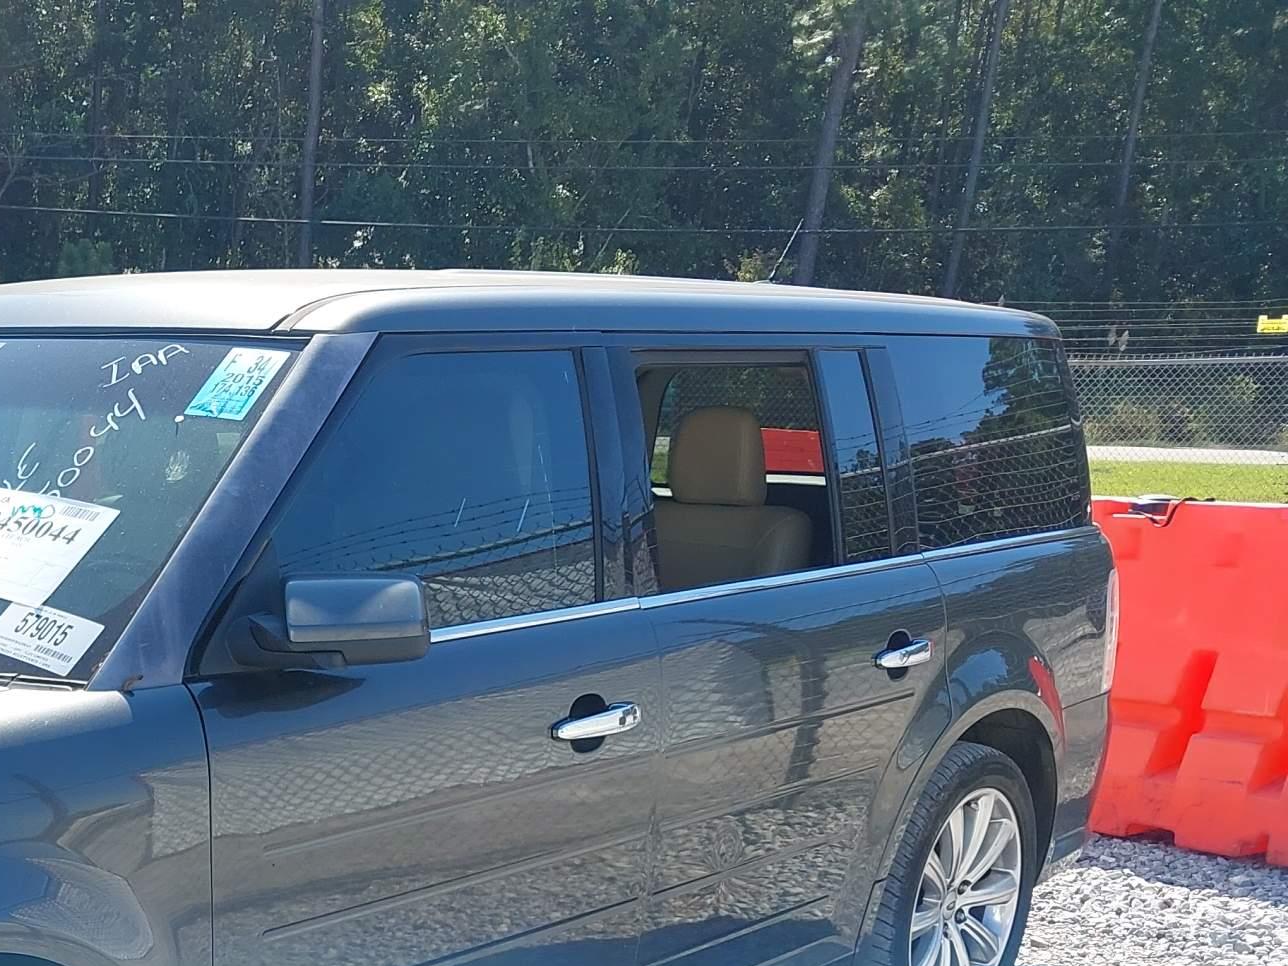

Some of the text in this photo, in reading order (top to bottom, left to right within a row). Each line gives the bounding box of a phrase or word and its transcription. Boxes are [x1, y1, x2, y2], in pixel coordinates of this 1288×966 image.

[101, 344, 190, 388] IAA
[220, 372, 266, 387] 2015
[46, 387, 146, 497] 0044
[14, 611, 73, 646] 579015
